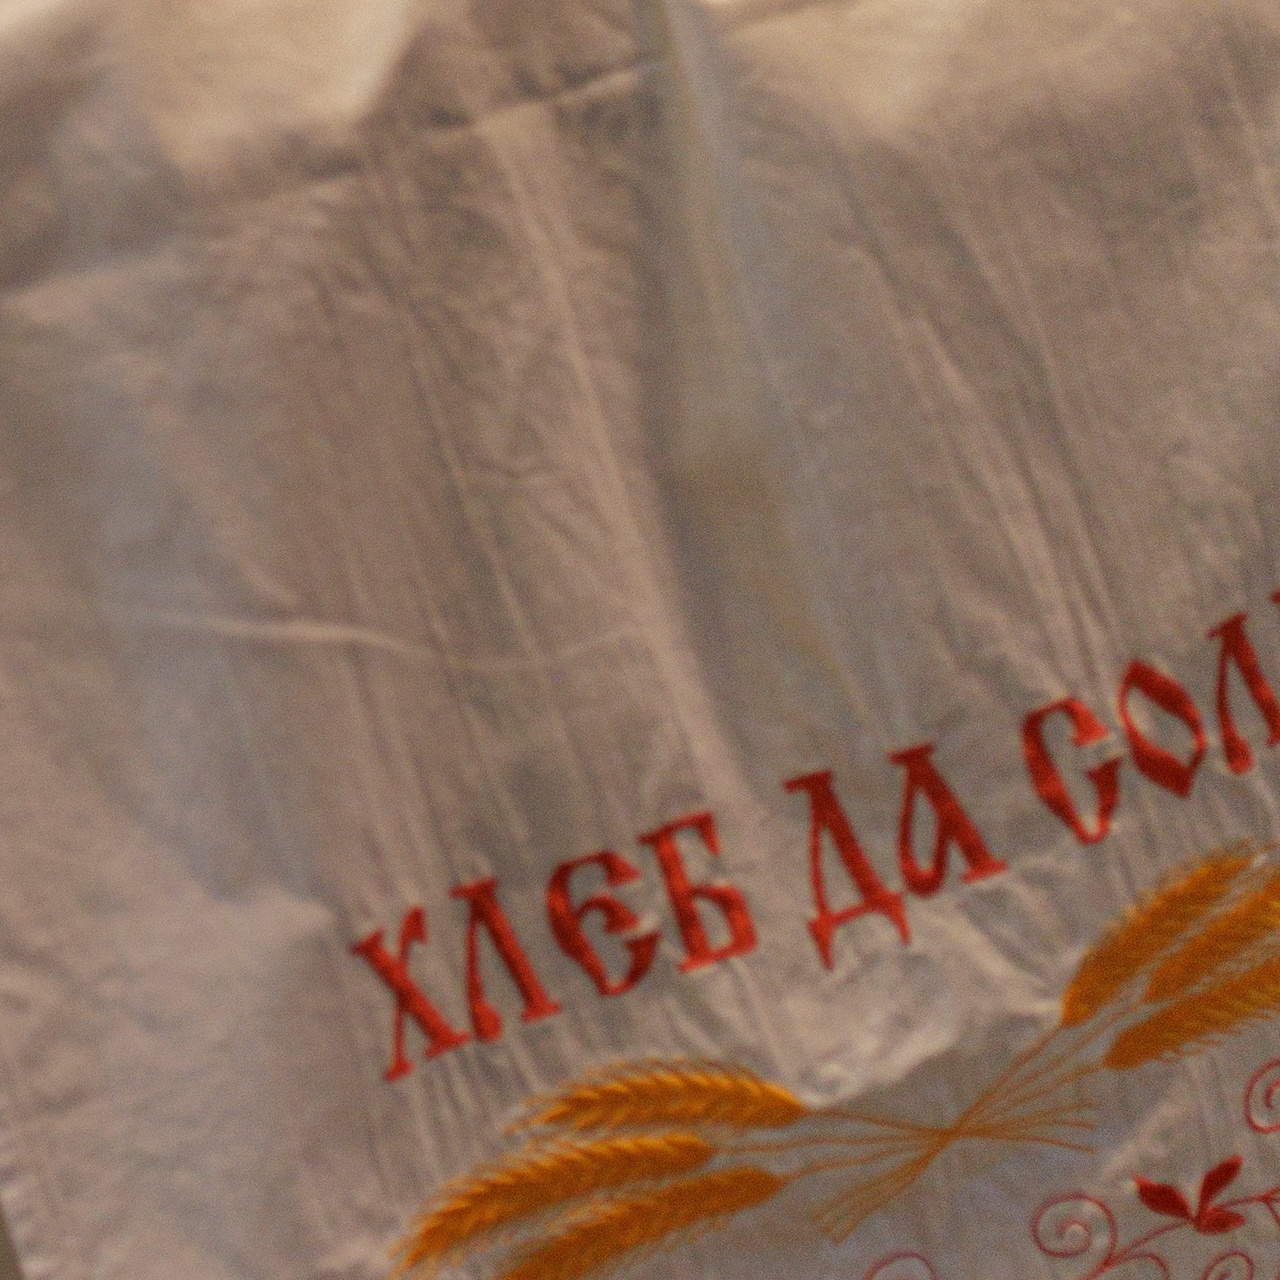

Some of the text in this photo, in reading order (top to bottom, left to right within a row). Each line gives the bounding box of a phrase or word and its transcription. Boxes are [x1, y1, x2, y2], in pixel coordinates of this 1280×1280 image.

[351, 590, 1280, 1082] ХЛЕБ ДА СОЛ
